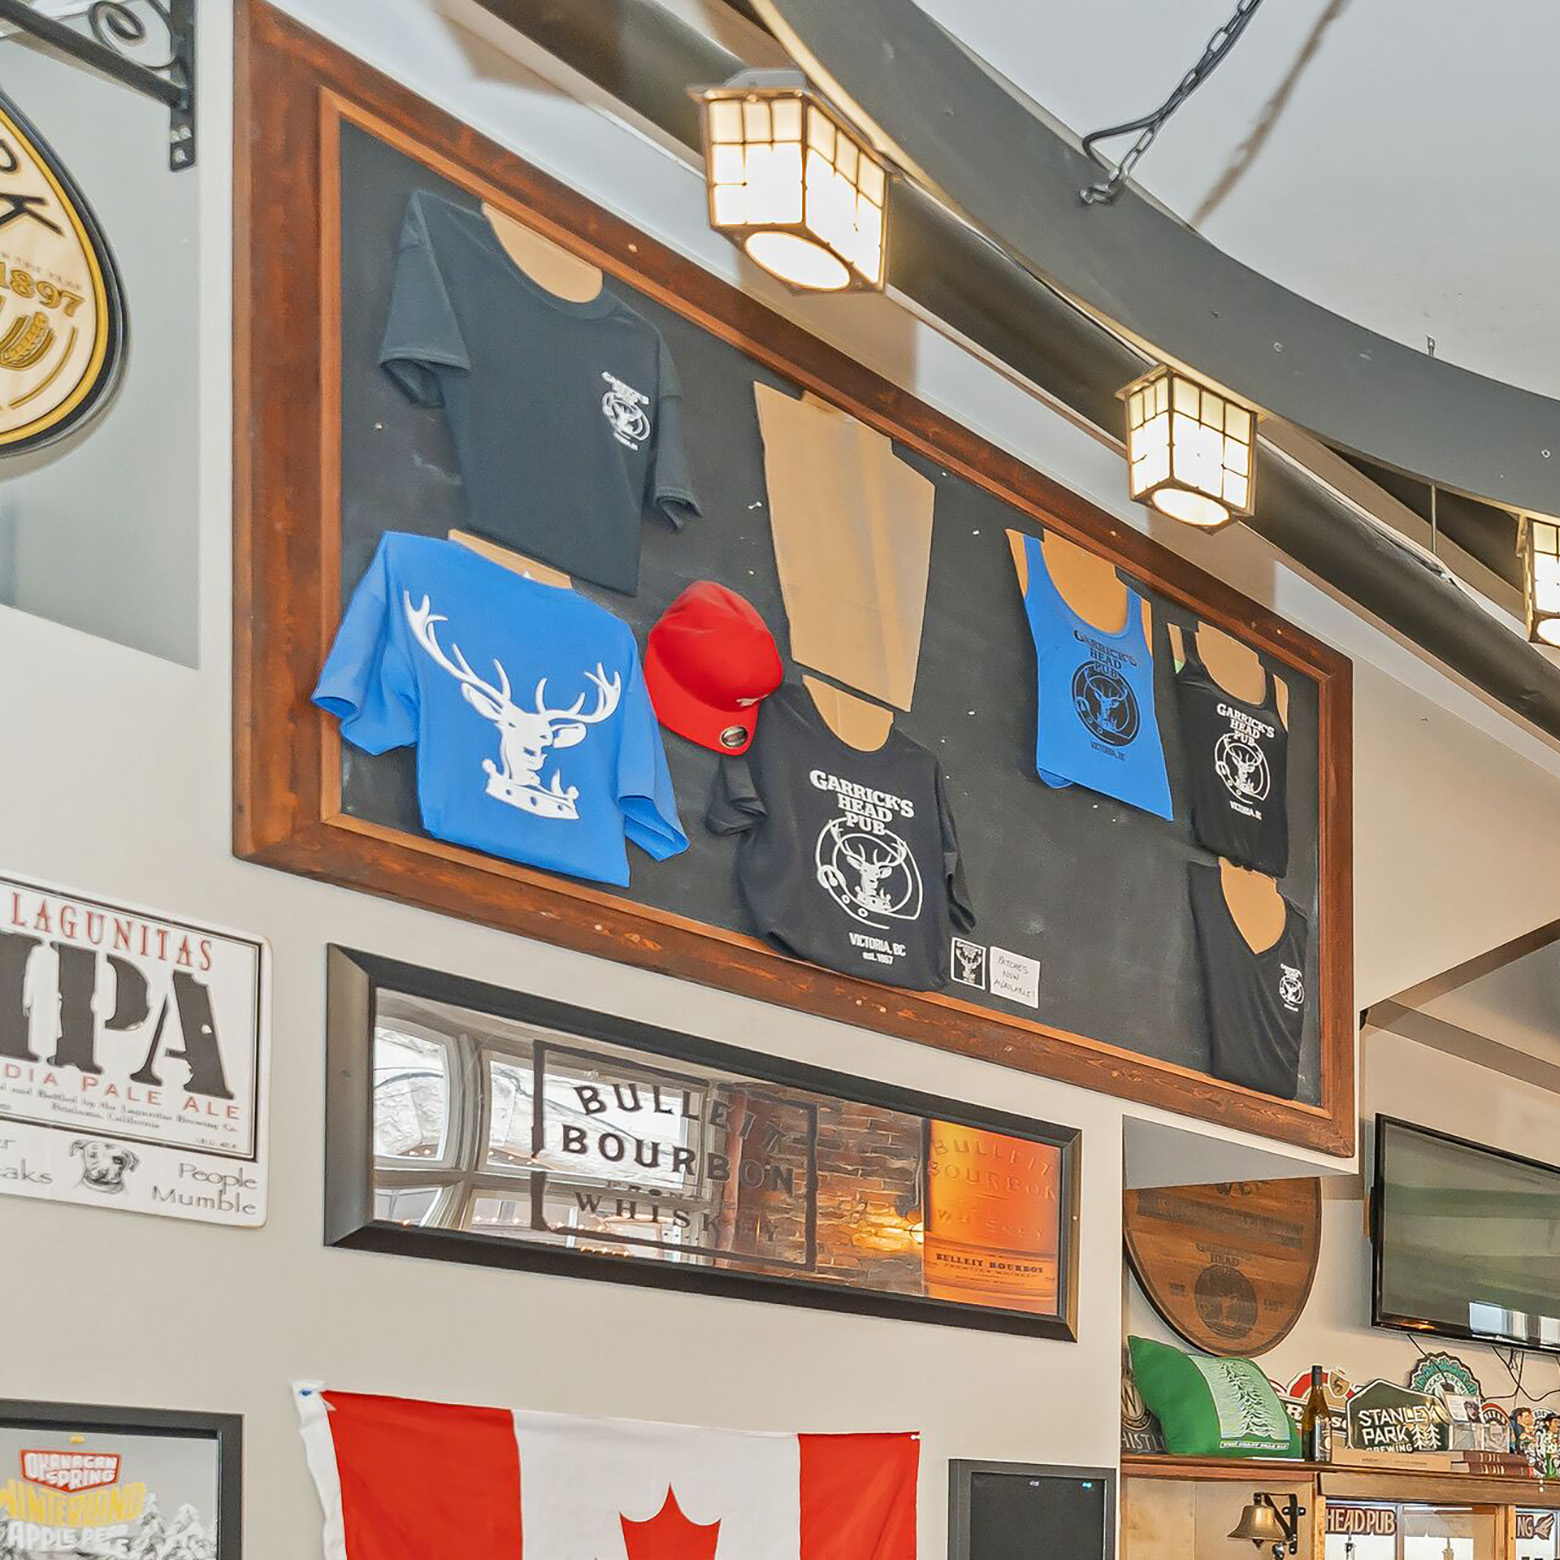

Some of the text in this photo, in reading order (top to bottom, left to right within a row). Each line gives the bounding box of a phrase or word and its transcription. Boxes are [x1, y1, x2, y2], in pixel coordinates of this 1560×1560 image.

[0, 261, 85, 318] 1897
[1090, 648, 1122, 669] HEAD
[1094, 662, 1118, 679] PUB
[1216, 703, 1275, 738] GARRICK'S
[1230, 718, 1260, 739] HEAD
[1233, 730, 1255, 746] PUB
[809, 769, 915, 819] GARRICK'S
[837, 793, 893, 822] HEAD
[846, 812, 886, 836] PUB
[12, 892, 214, 973] LAGUNITAS
[892, 941, 907, 957] BC
[0, 930, 235, 1100] IPA
[81, 1075, 163, 1107] PALE
[182, 1095, 241, 1121] ALE
[573, 1082, 789, 1152] BULLEIT
[562, 1124, 796, 1197] BOURBON
[935, 1138, 1053, 1177] BULLEIT
[178, 1162, 258, 1198] People
[150, 1185, 258, 1216] Mumble
[936, 1252, 1044, 1274] BULLEIT BOURBON
[1357, 1404, 1436, 1427] STANLEY
[1362, 1426, 1409, 1446] PARK
[24, 1453, 119, 1481] OKANAGAN
[45, 1468, 116, 1491] SPRING
[8, 1520, 79, 1550] APPLE
[1326, 1508, 1396, 1533] HEAD PUB
